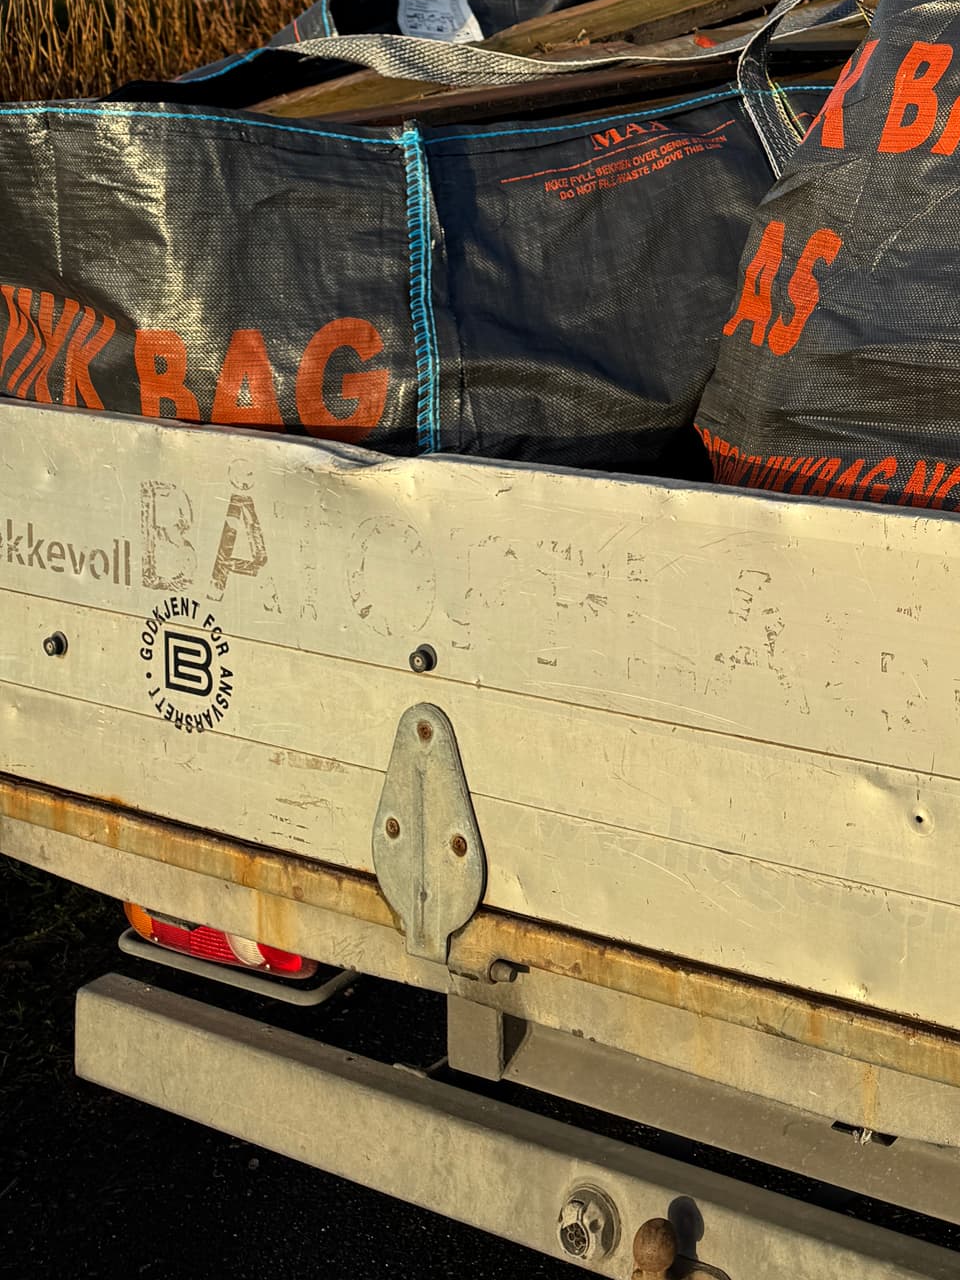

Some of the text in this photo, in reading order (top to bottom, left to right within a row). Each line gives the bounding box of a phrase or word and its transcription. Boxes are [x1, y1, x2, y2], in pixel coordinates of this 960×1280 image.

[544, 178, 568, 192] IKKE
[569, 172, 596, 188] FYLL
[632, 148, 660, 166] OVER
[591, 121, 670, 151] MAX
[559, 189, 575, 200] DO
[576, 181, 597, 196] NOT
[651, 149, 684, 172] ABOVE
[723, 220, 843, 356] AS
[134, 317, 390, 442] BAG
[0, 519, 131, 587] kkevoll
[140, 596, 234, 734] GODKJENT FOR ANSVARSRETT
